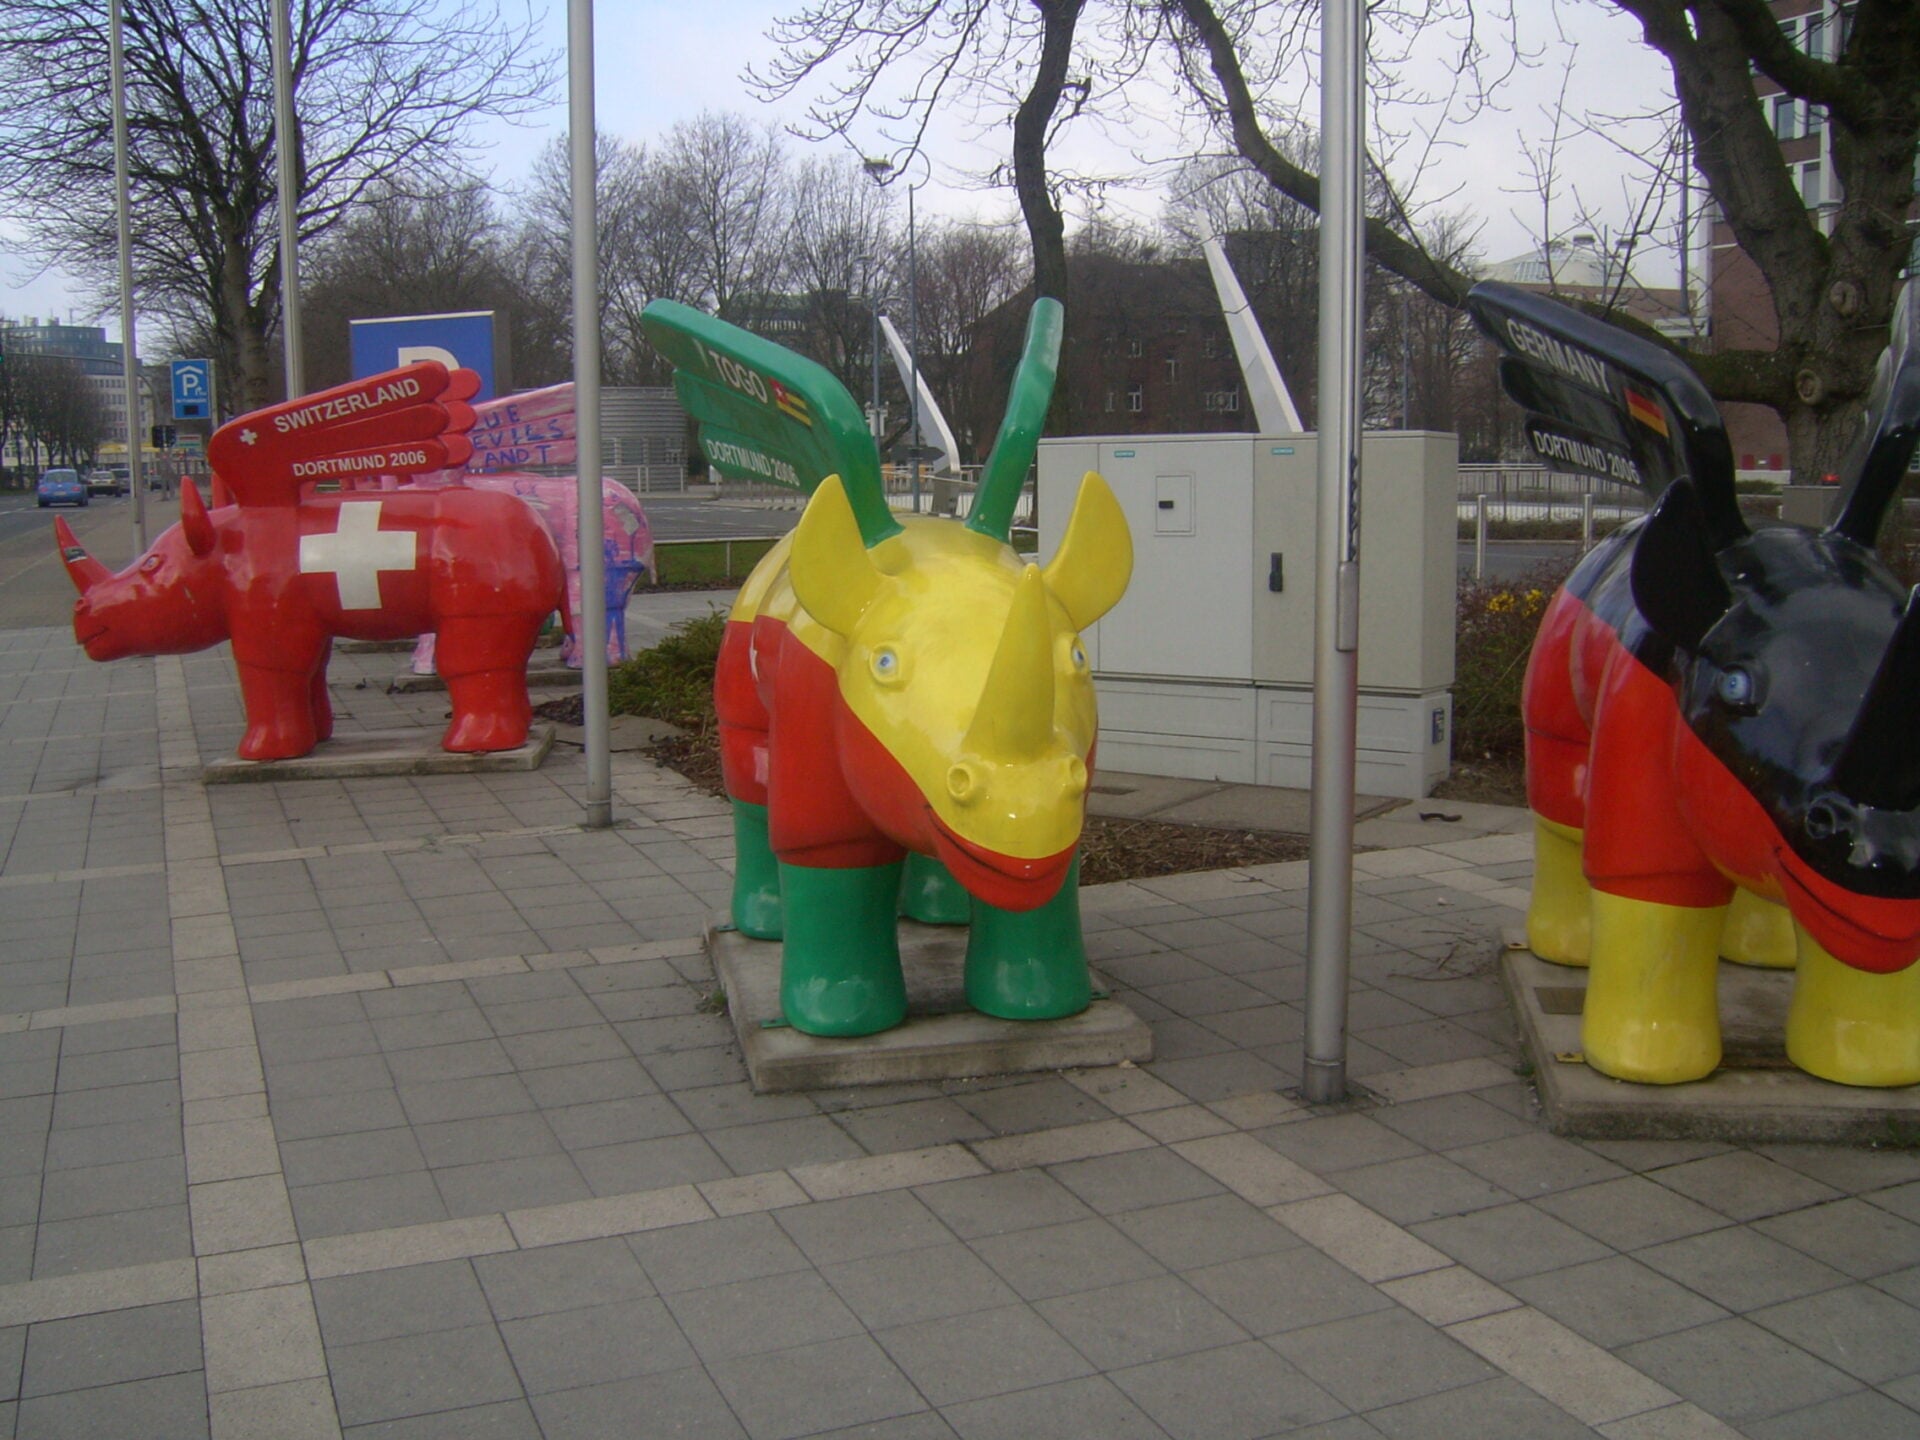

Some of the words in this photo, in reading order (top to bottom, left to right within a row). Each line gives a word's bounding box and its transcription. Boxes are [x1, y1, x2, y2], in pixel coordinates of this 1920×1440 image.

[709, 349, 768, 404] TOGO
[1507, 318, 1610, 394] GERMANY
[182, 373, 199, 396] P
[274, 378, 420, 433] SWITZERLAND
[292, 454, 386, 477] DORTMUND
[390, 450, 427, 468] 2006
[706, 439, 772, 477] DORTMUND
[1533, 430, 1607, 473] DORTMUND
[1607, 452, 1640, 485] 2006
